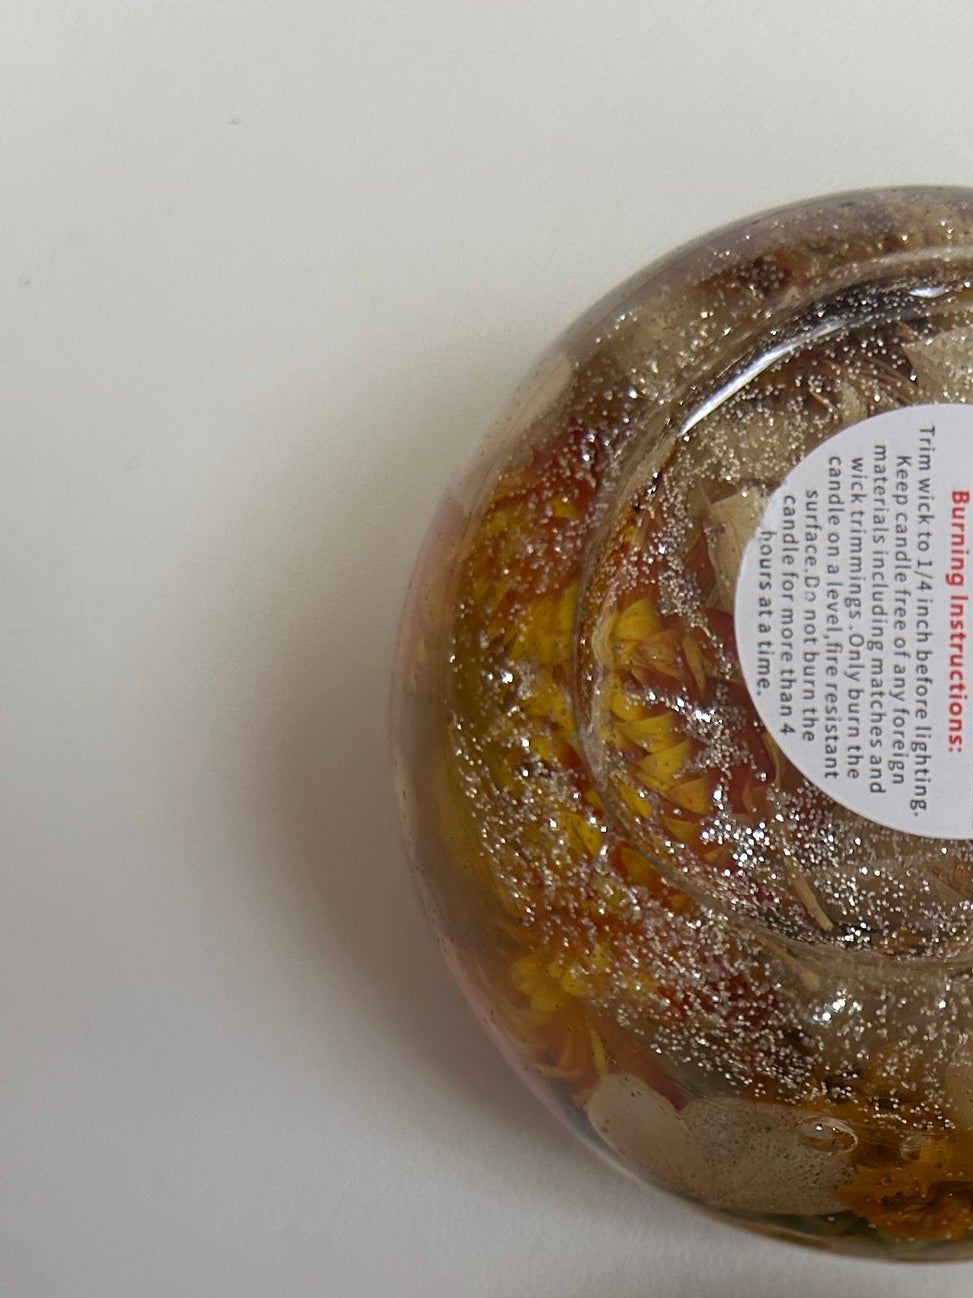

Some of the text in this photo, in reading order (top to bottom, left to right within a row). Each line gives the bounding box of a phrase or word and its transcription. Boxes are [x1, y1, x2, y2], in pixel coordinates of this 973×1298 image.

[827, 455, 846, 526] candle
[850, 456, 868, 504] wick
[826, 532, 841, 557] on
[826, 563, 840, 575] a
[756, 530, 778, 696] hours at a time.
[779, 494, 800, 736] candle for more than 4
[803, 609, 819, 645] not
[866, 444, 890, 794] materials including matches and
[887, 455, 913, 785] Keep candle free of any foreign
[909, 425, 937, 817] Trim wick to 1/4 inch before lighting.
[944, 490, 971, 753] Burning Instructions:
[802, 650, 821, 701] burn
[801, 707, 820, 742] the
[823, 682, 842, 780] resistant
[847, 687, 866, 738] burn
[846, 744, 865, 780] the
